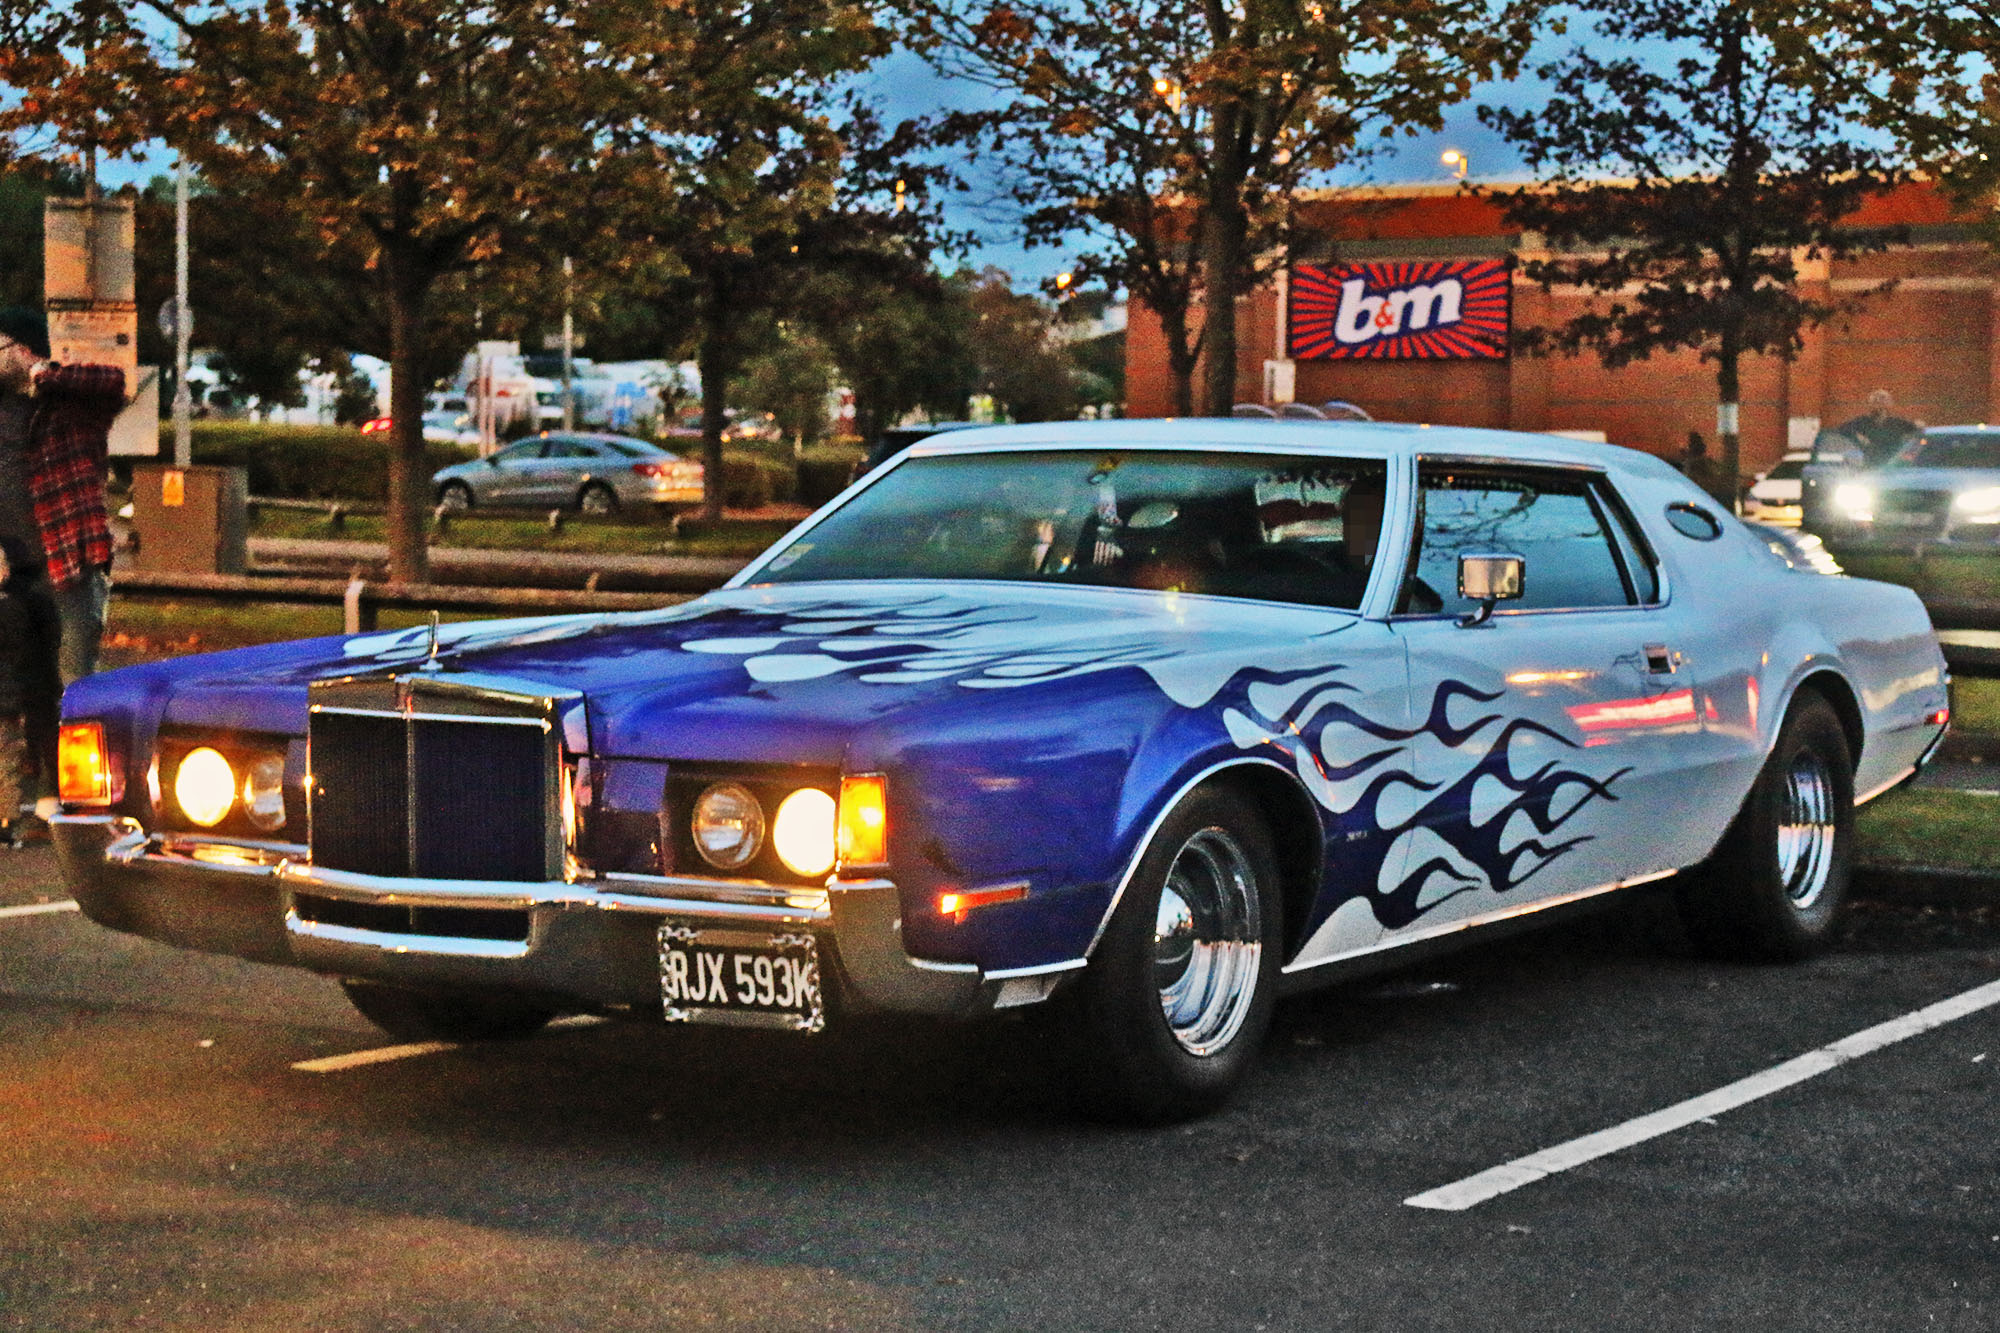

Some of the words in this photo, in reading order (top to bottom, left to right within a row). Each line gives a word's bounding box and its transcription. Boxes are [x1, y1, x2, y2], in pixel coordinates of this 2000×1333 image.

[1335, 279, 1462, 343] b&m
[669, 951, 728, 1003] RJX
[734, 954, 812, 1008] 593K
